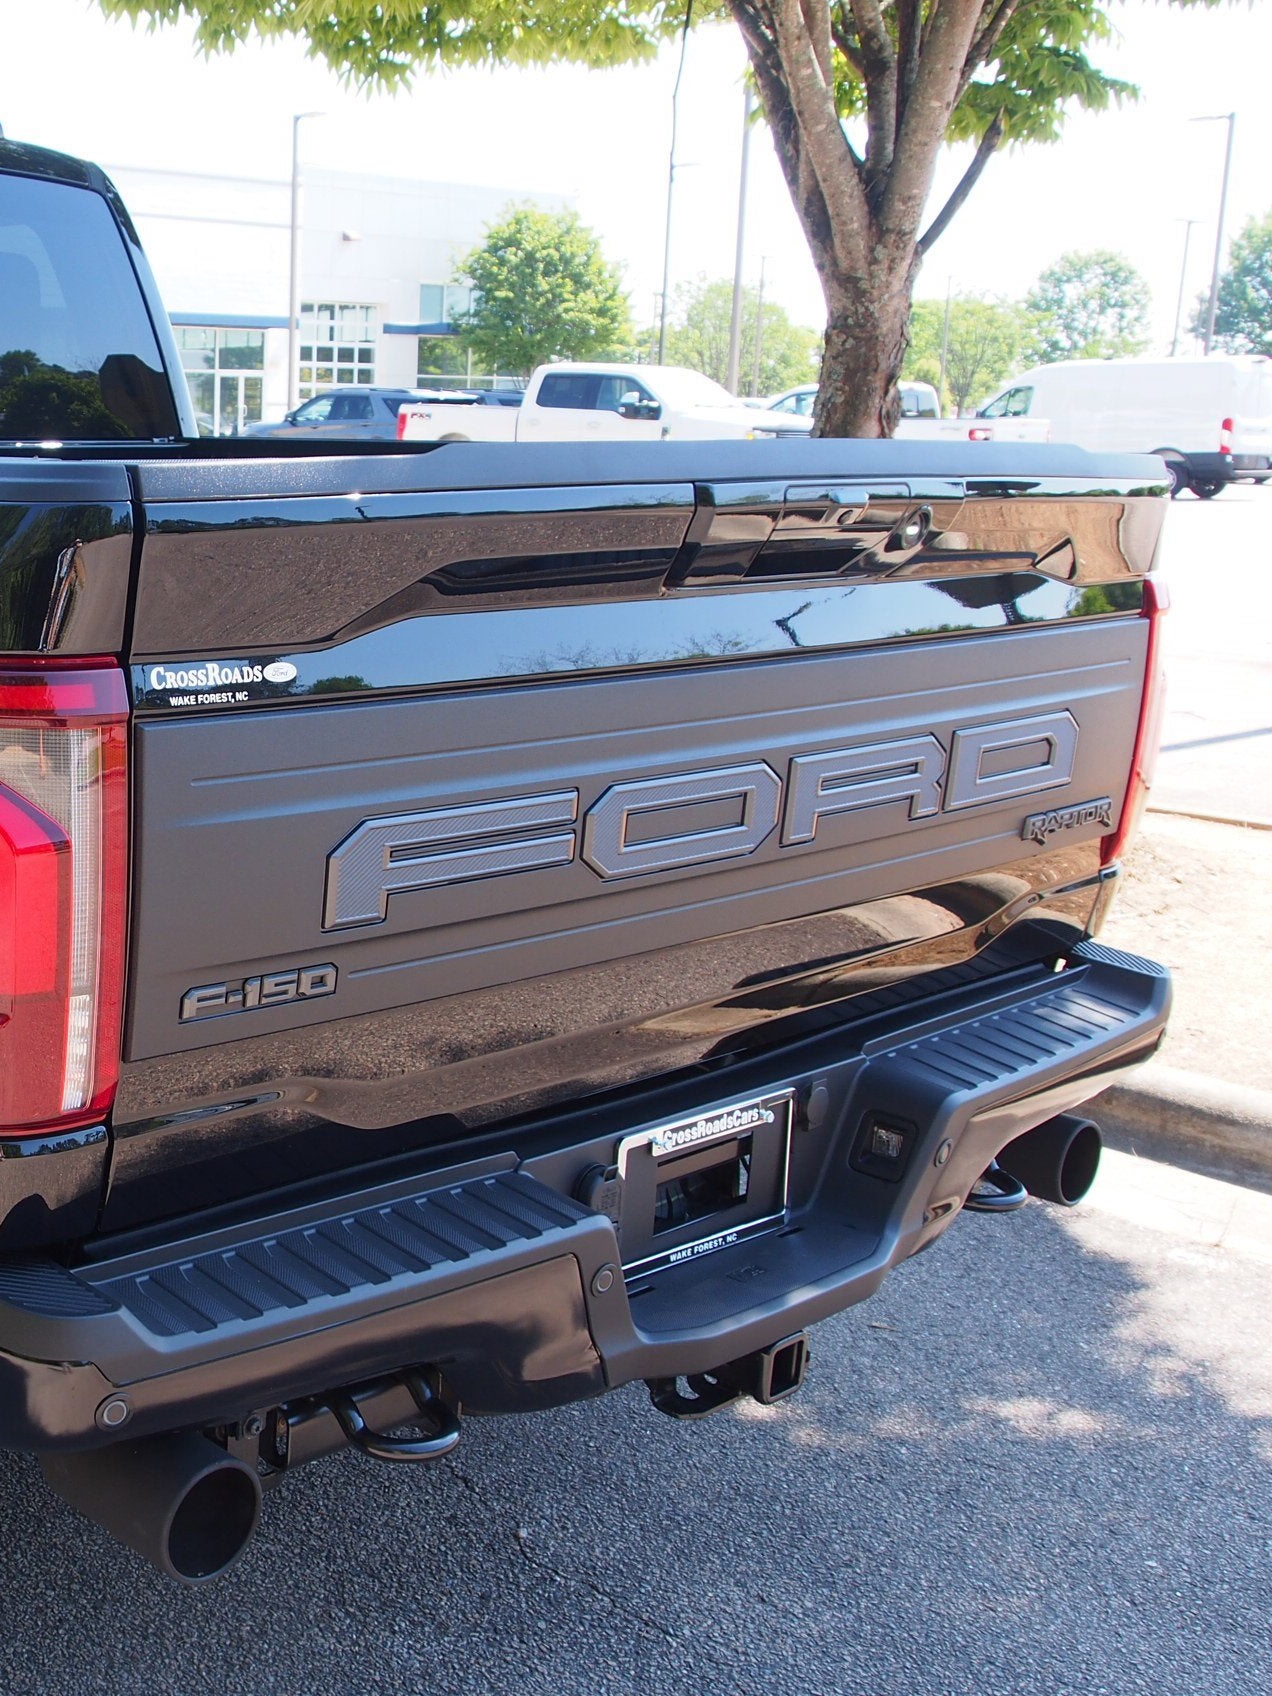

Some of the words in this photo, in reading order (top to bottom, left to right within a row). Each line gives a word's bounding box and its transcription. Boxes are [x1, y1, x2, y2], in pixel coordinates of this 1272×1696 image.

[169, 695, 197, 707] WAKE
[197, 692, 235, 704] FOREST,
[235, 691, 249, 701] NC
[322, 709, 1080, 932] FORD
[1023, 797, 1113, 845] RAPTOR
[179, 962, 339, 1020] F-150
[669, 1248, 692, 1262] WAKE
[694, 1237, 725, 1254] FOREST,
[726, 1232, 738, 1243] NC
